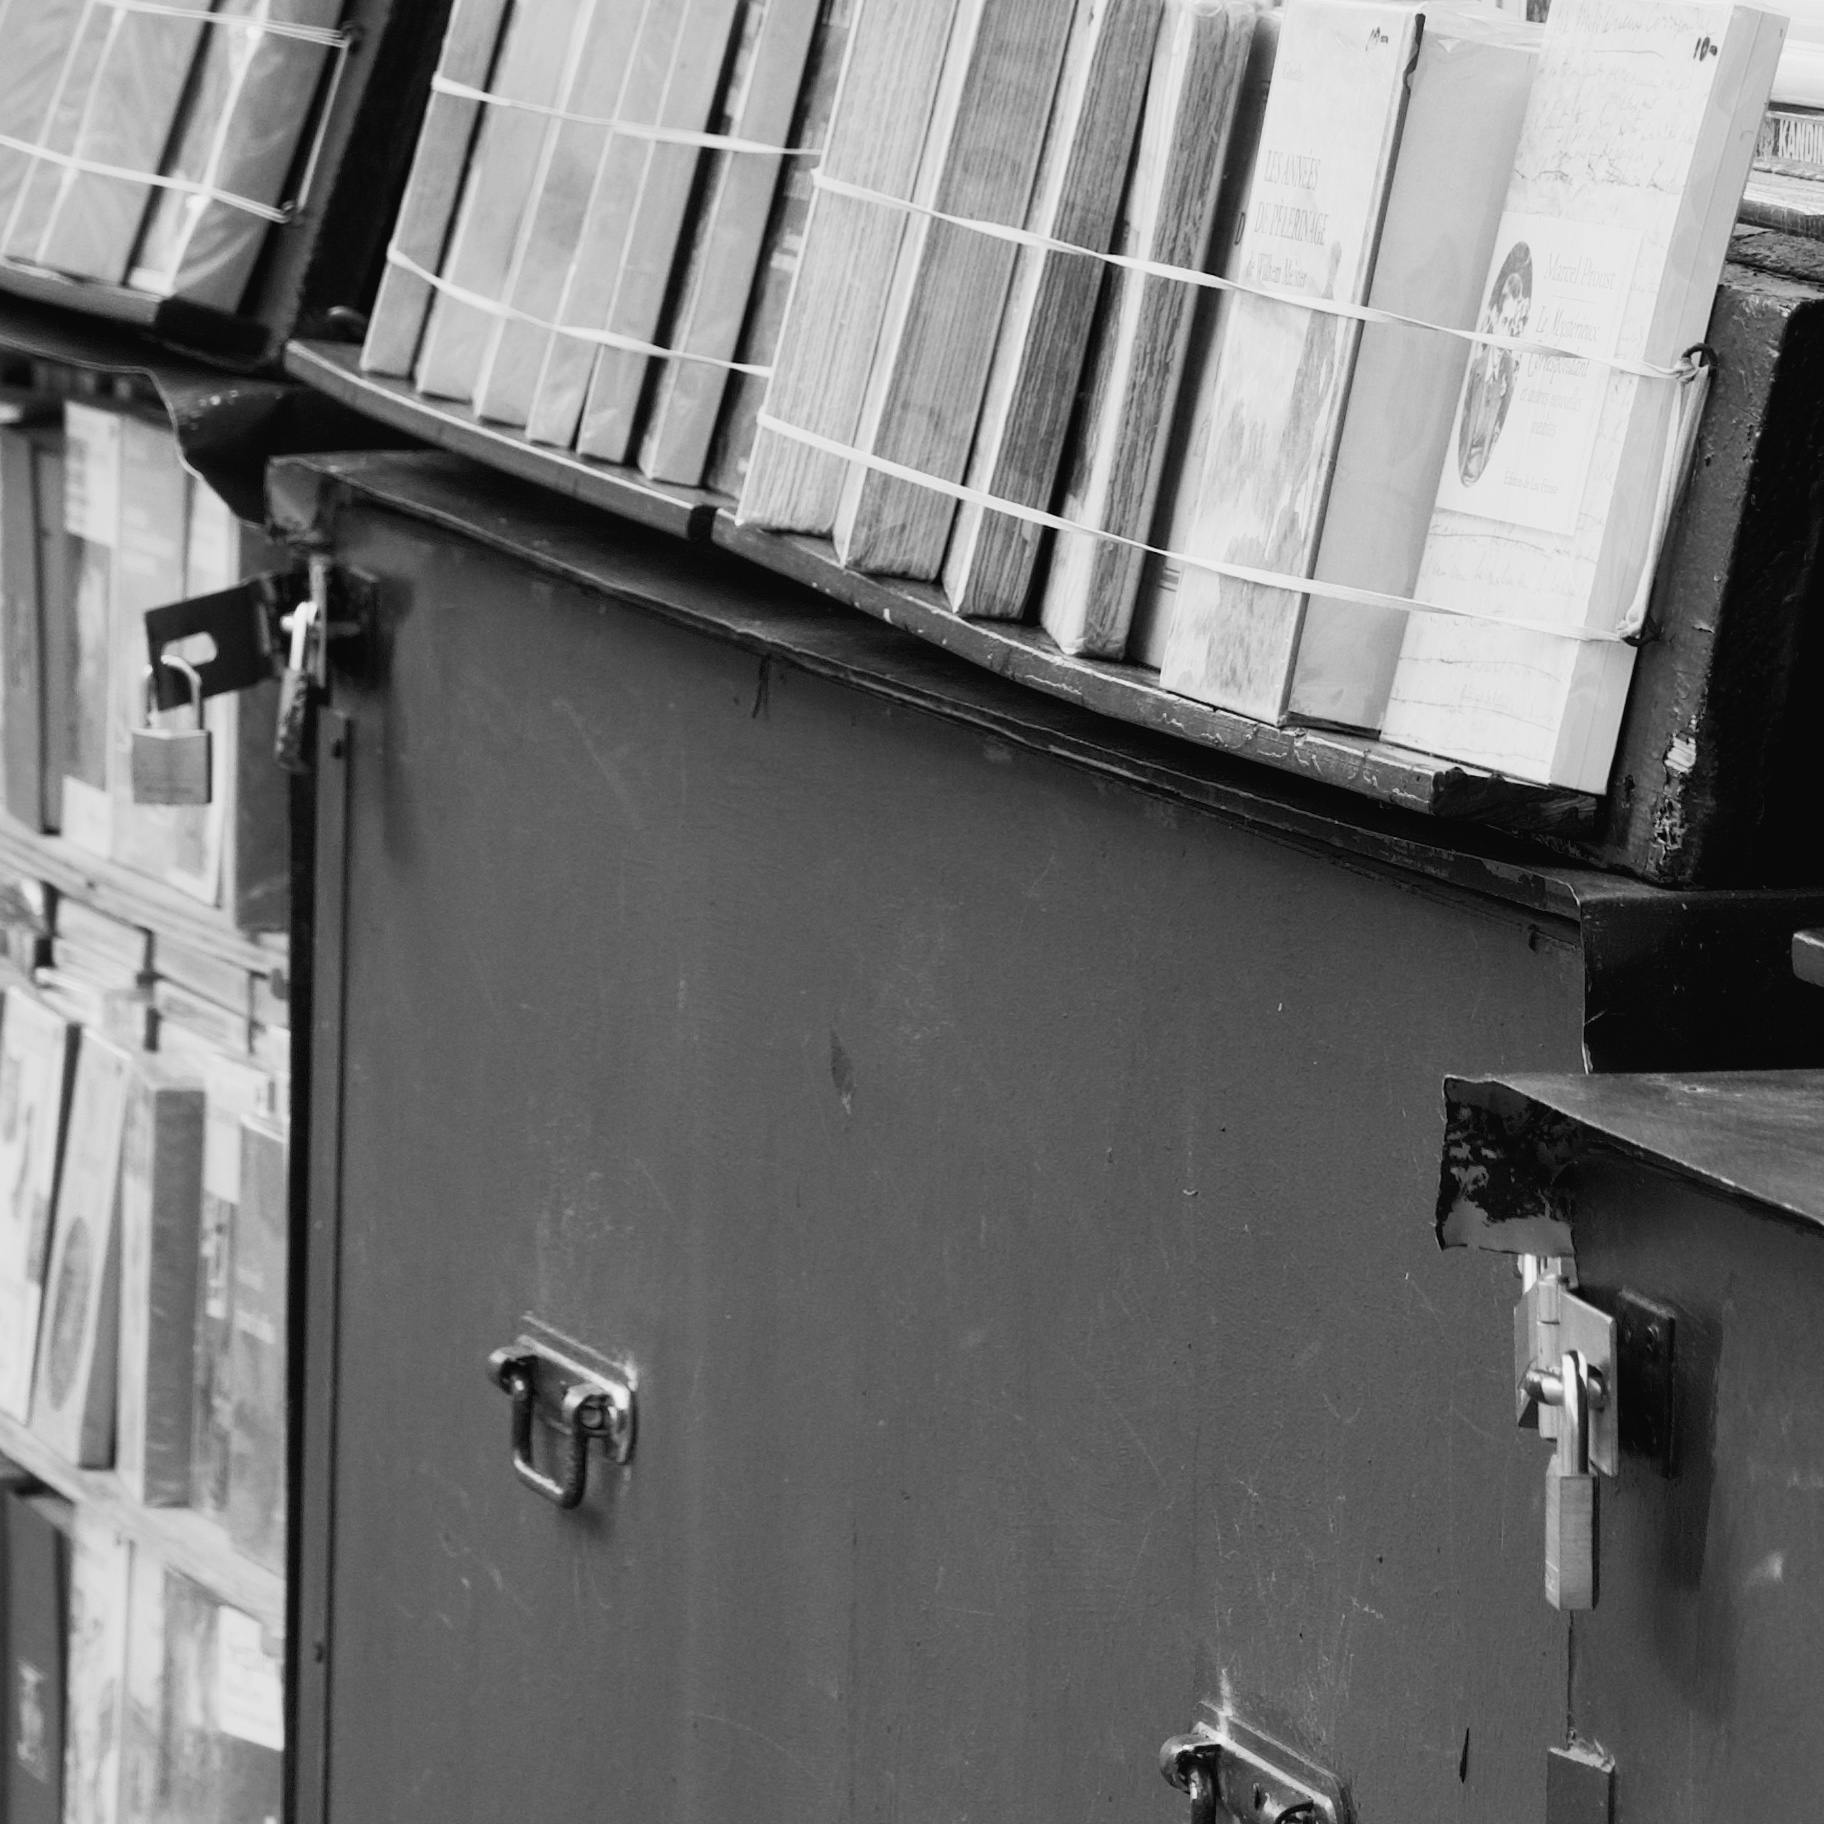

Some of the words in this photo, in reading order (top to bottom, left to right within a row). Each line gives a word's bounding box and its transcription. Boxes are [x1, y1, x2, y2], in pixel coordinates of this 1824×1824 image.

[1263, 149, 1281, 185] LES
[1254, 201, 1269, 234] DE
[1543, 252, 1578, 284] Marcel
[1578, 255, 1616, 290] Proust
